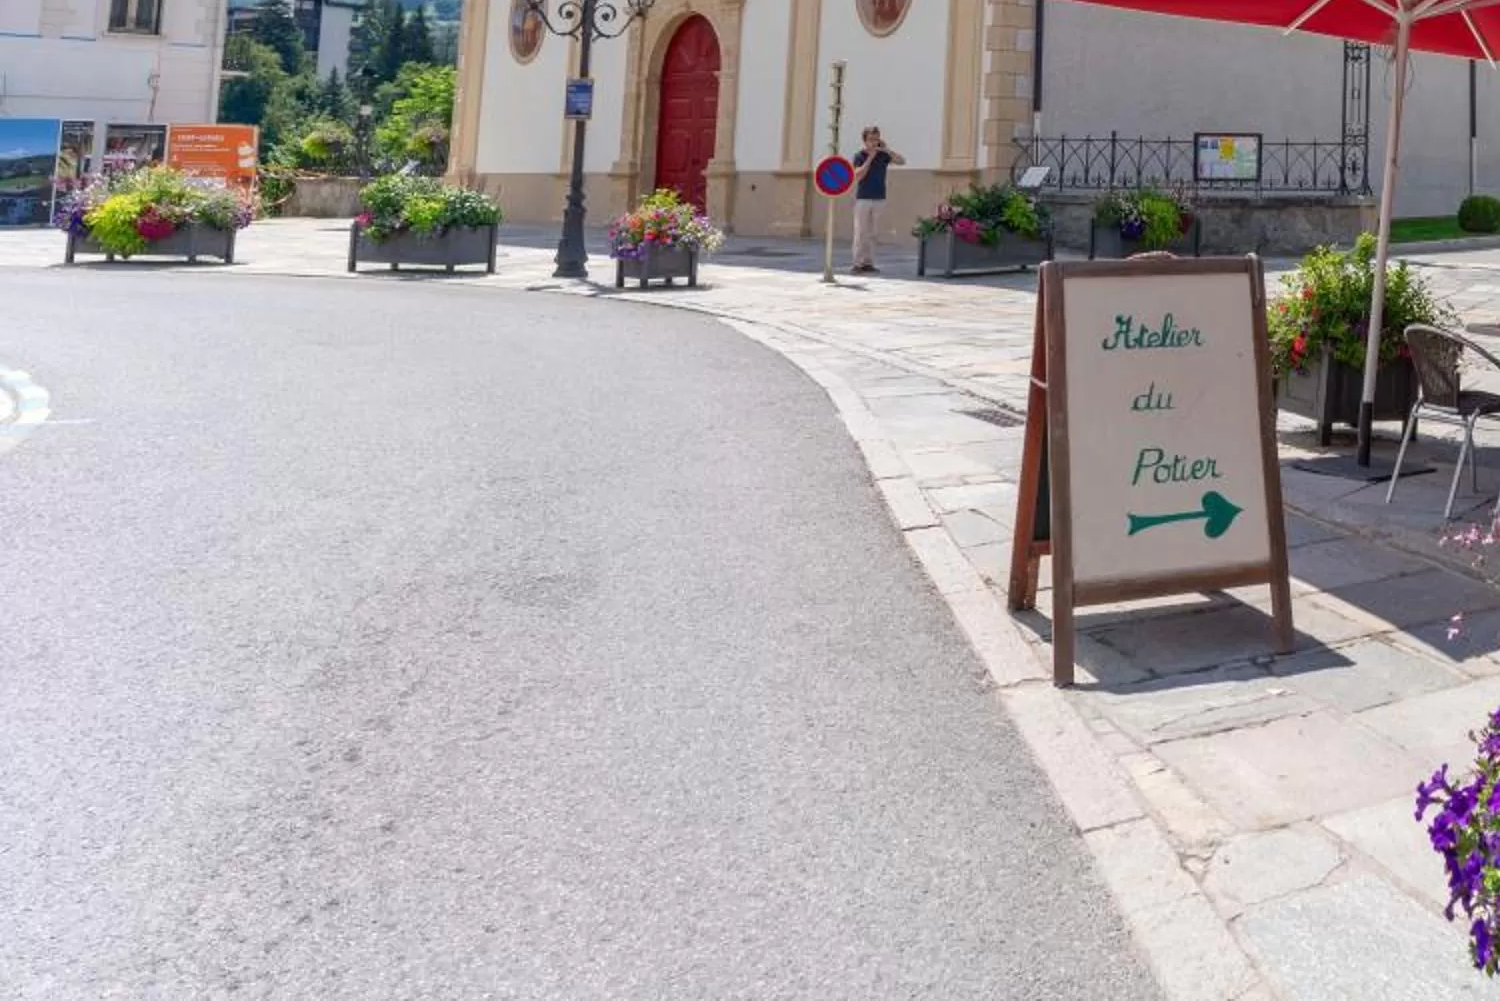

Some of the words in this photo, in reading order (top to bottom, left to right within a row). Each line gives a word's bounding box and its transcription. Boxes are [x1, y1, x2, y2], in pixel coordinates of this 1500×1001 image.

[1102, 312, 1206, 351] Atelier
[1130, 380, 1176, 412] du
[1131, 447, 1224, 487] Potier
